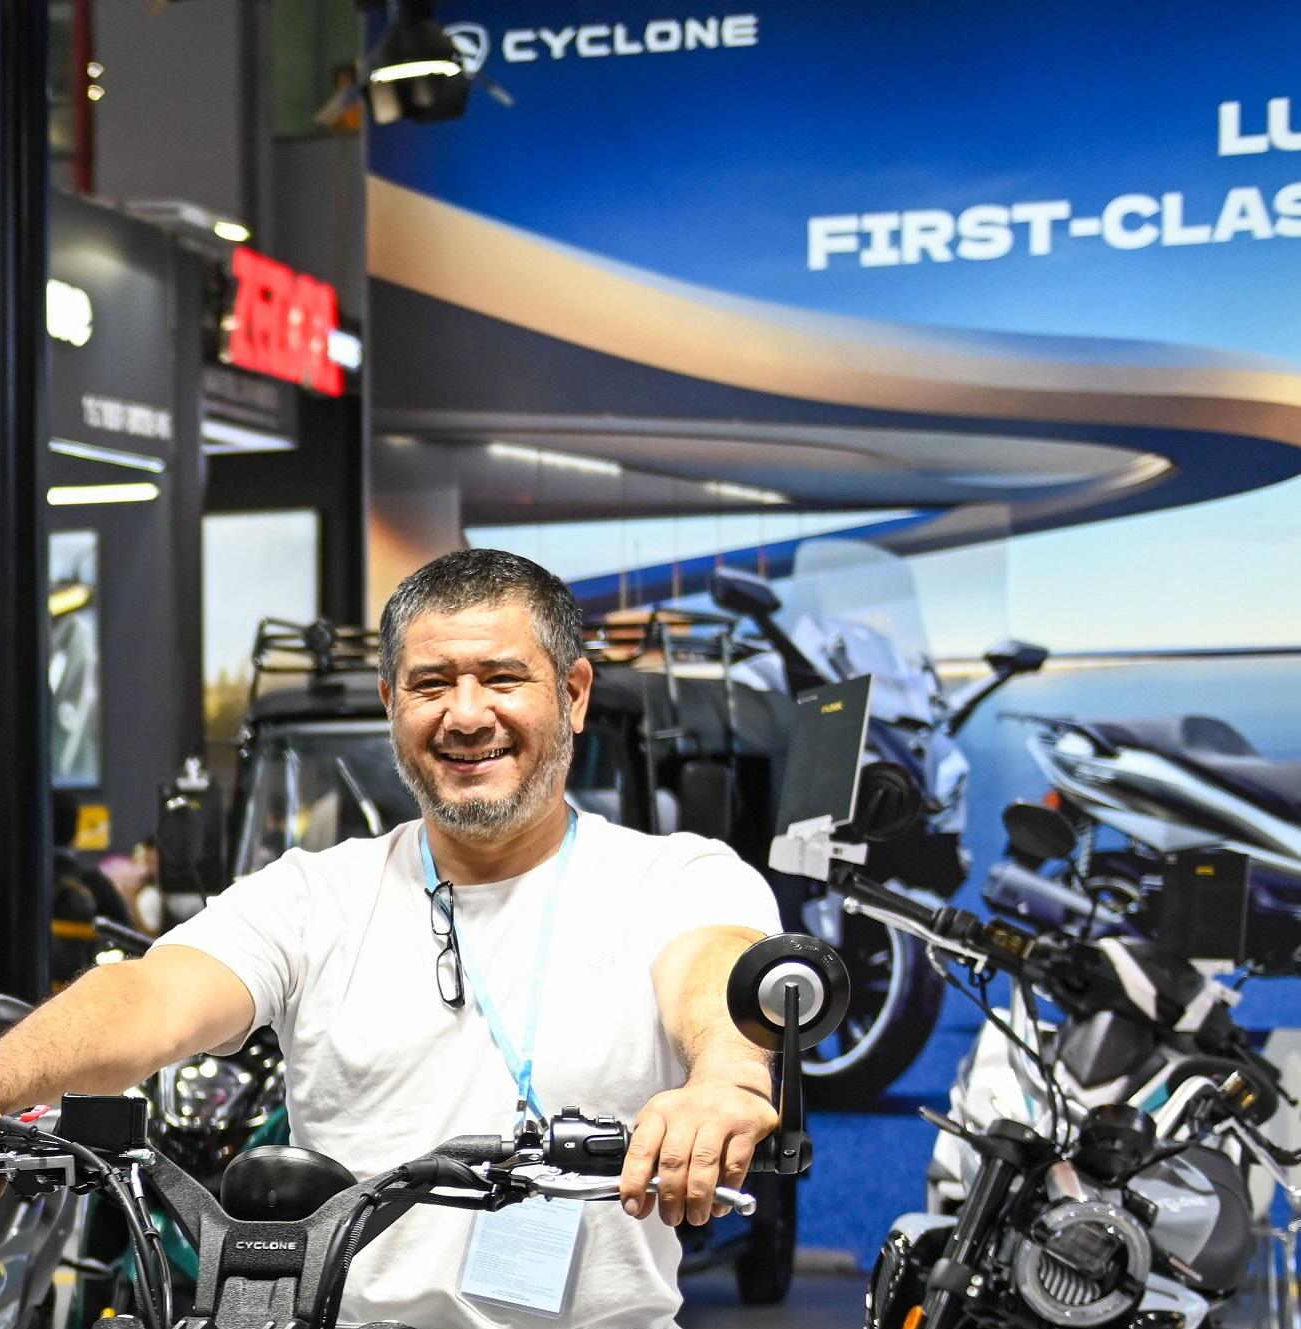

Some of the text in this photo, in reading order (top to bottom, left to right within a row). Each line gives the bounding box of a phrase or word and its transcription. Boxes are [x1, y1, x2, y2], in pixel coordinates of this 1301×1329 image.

[502, 12, 760, 64] CYCLONE
[1217, 96, 1301, 157] LU
[235, 1240, 297, 1250] CYCLONE
